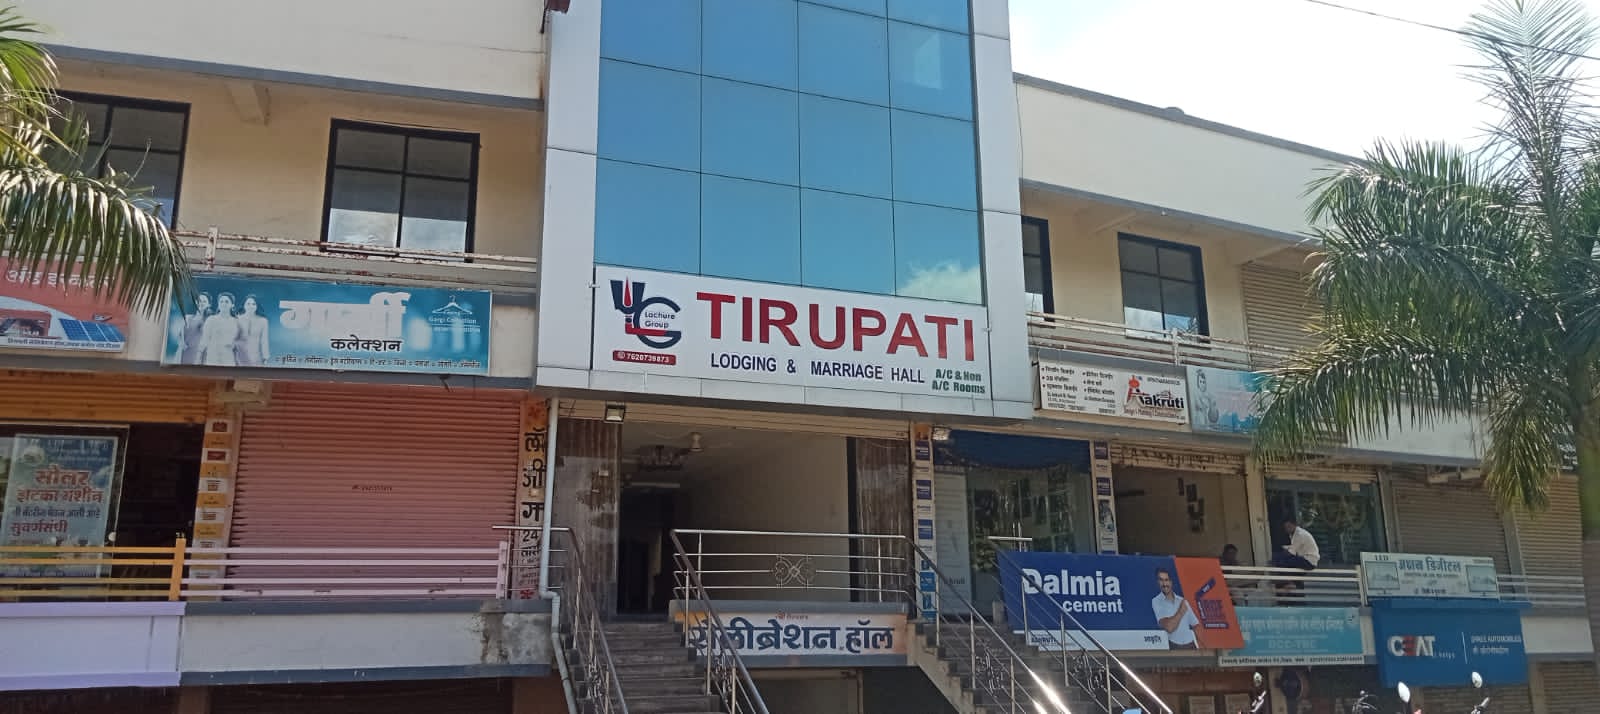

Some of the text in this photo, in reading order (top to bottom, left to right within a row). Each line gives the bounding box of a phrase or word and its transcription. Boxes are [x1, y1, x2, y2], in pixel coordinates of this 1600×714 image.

[644, 320, 670, 329] Group
[696, 291, 975, 362] TIRUPATI
[330, 334, 402, 352] कलेक्शन
[710, 352, 925, 384] LODGING & MARRIAGE HALL
[935, 368, 953, 380] A/C
[931, 380, 986, 395] A/C Rooms
[1022, 568, 1121, 596] Dalmia
[1062, 599, 1123, 613] cement
[845, 619, 895, 654] हॉल
[1387, 635, 1436, 657] CEAT
